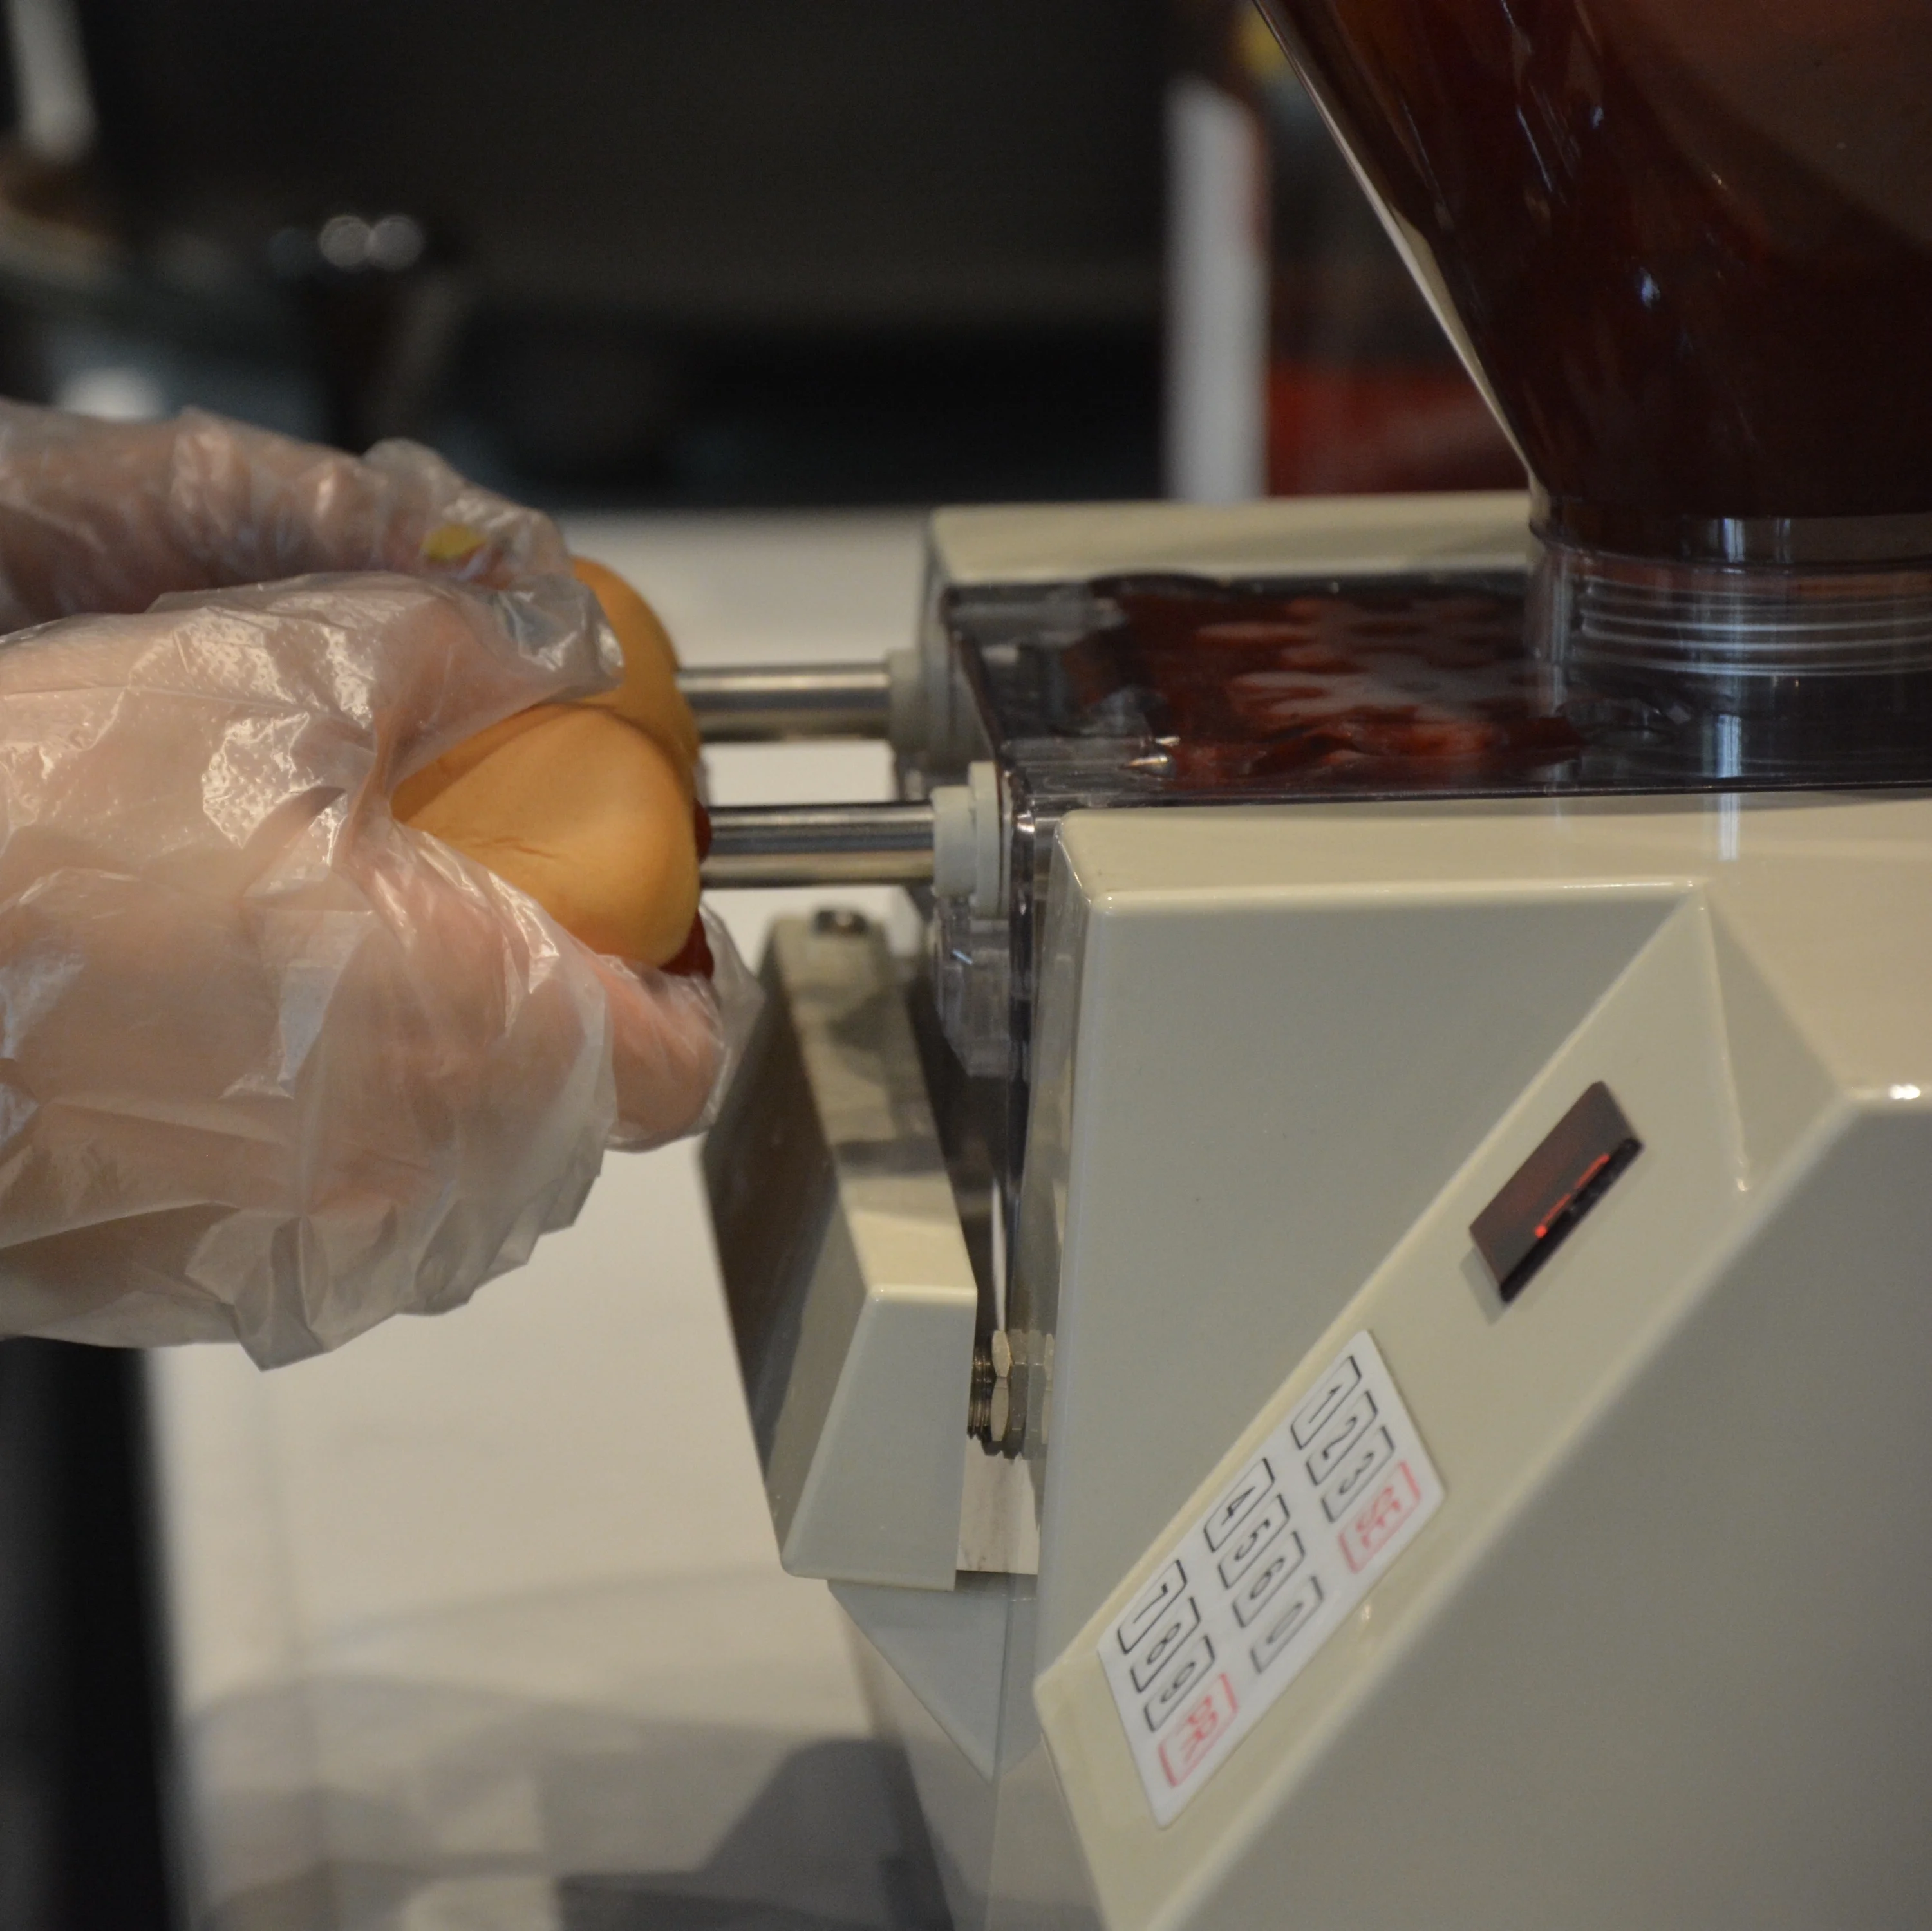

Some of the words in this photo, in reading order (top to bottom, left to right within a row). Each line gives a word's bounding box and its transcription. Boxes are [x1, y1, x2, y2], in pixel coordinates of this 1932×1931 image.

[1308, 1385, 1340, 1423] 1
[1322, 1415, 1358, 1460] 2
[1339, 1451, 1374, 1494] 3
[1222, 1486, 1256, 1526] 4
[1235, 1520, 1270, 1562] 5
[1249, 1556, 1284, 1600] 6
[1133, 1583, 1168, 1623] 7
[1146, 1621, 1181, 1665] 8
[1160, 1661, 1195, 1702] 9
